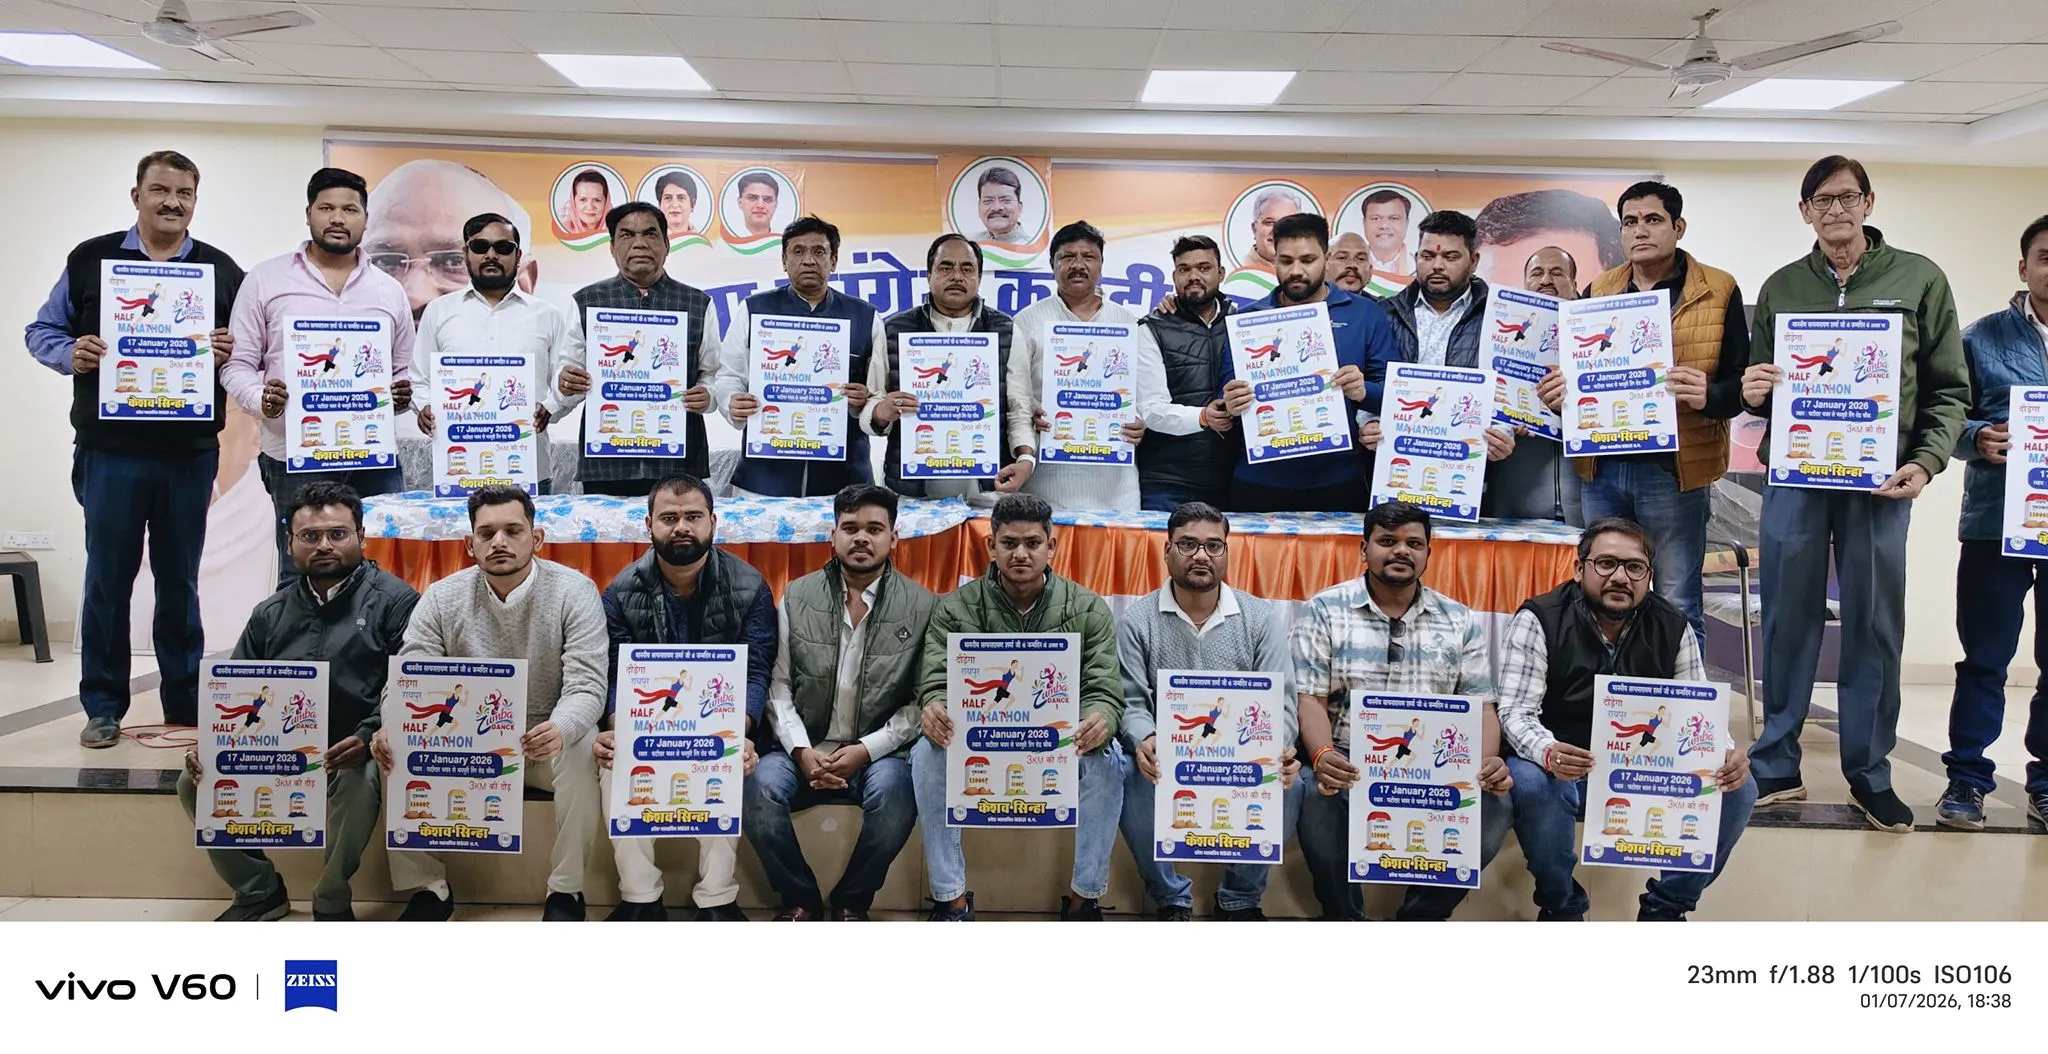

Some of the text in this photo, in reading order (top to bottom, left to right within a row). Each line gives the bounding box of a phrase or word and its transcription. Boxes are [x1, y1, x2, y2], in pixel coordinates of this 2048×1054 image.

[113, 313, 134, 321] HALF
[138, 339, 168, 348] January
[760, 362, 778, 370] HALF
[1245, 361, 1264, 370] HALF
[1586, 370, 1647, 382] 17 January 2026
[1788, 372, 1810, 381] HALF
[619, 383, 646, 392] January
[647, 384, 664, 392] 2026
[1270, 380, 1298, 391] January
[1298, 377, 1316, 386] 2026
[321, 394, 350, 402] January
[351, 393, 369, 401] 2026
[1073, 392, 1098, 401] January
[1801, 400, 1869, 410] 17 January 2026
[1393, 413, 1412, 422] HALF
[1402, 437, 1462, 451] 17 January 2026
[962, 698, 985, 708] HALF
[630, 708, 653, 717] HALF
[966, 709, 1029, 722] MARATHON
[212, 723, 235, 732] HALF
[402, 722, 427, 732] HALF
[633, 719, 696, 731] MARATHON
[216, 733, 279, 747] MARATHON
[977, 729, 1049, 740] 17 January 2026
[1170, 733, 1193, 743] HALF
[407, 733, 473, 748] MARATHON
[644, 738, 715, 749] 17 January 2026
[1606, 740, 1630, 751] HALF
[1175, 744, 1235, 758] MARATHON
[227, 753, 297, 763] 17 January 2026
[418, 754, 493, 766] 17 January 2026
[1364, 753, 1387, 764] HALF
[1610, 751, 1674, 768] MARATHON
[1185, 764, 1253, 775] 17 January 2026
[1368, 765, 1431, 781] MARATHON
[1619, 771, 1692, 785] 17 January 2026
[1379, 785, 1450, 798] 17 January 2026
[978, 799, 1045, 814] केशव सिन्हा
[641, 808, 709, 823] केशव सिन्हा
[226, 820, 293, 835] केशव सिन्हा
[419, 822, 488, 839] केशव सिन्हा
[1185, 832, 1250, 848] केशव सिन्हा
[1615, 838, 1683, 857] केशव सिन्हा
[1379, 853, 1447, 872] केशव सिन्हा
